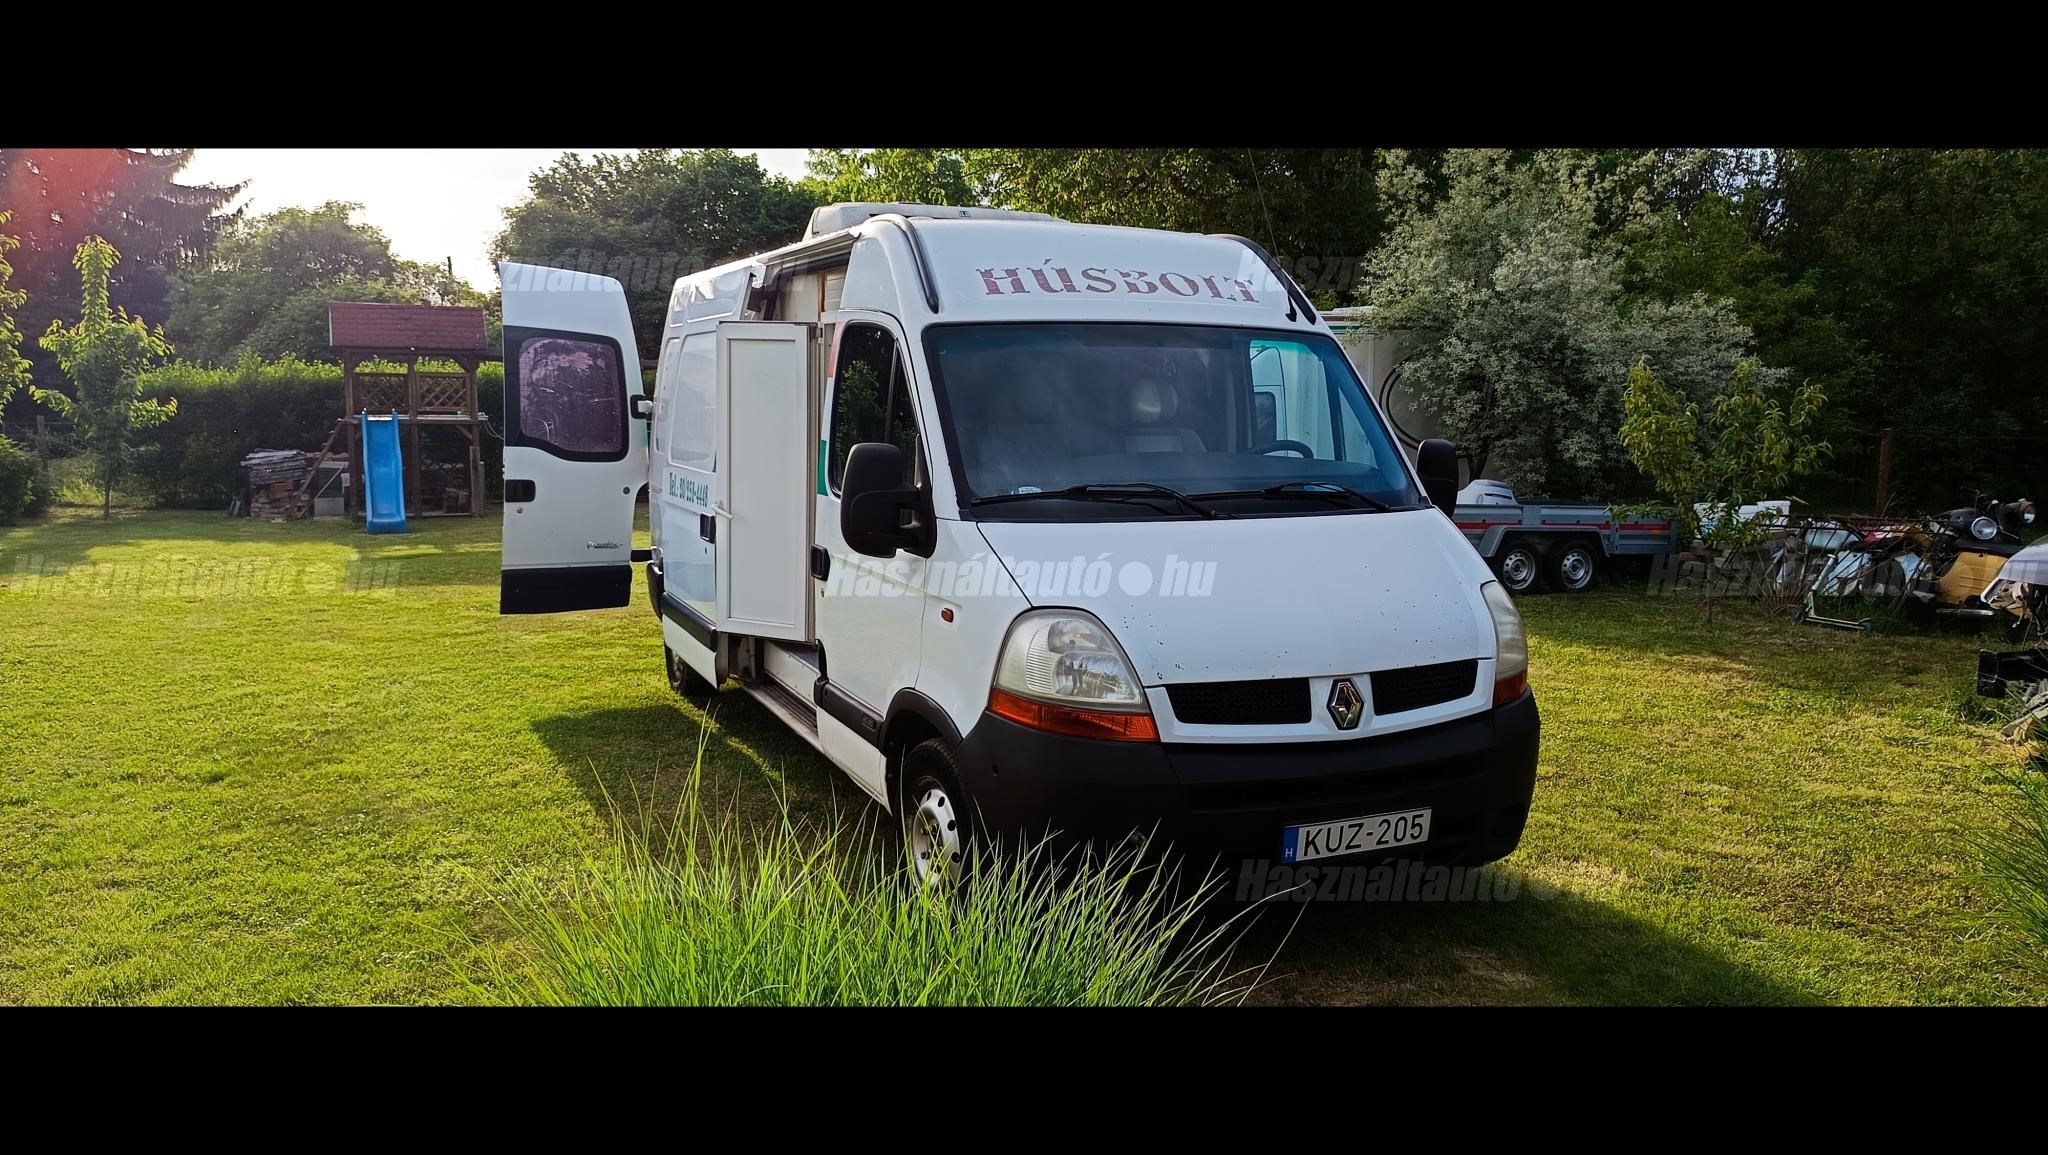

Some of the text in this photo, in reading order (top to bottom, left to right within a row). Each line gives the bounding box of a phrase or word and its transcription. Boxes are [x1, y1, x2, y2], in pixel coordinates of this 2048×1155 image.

[976, 258, 1259, 303] HÚSBOLT
[1285, 848, 1293, 858] H
[1304, 813, 1424, 857] KUZ-205
